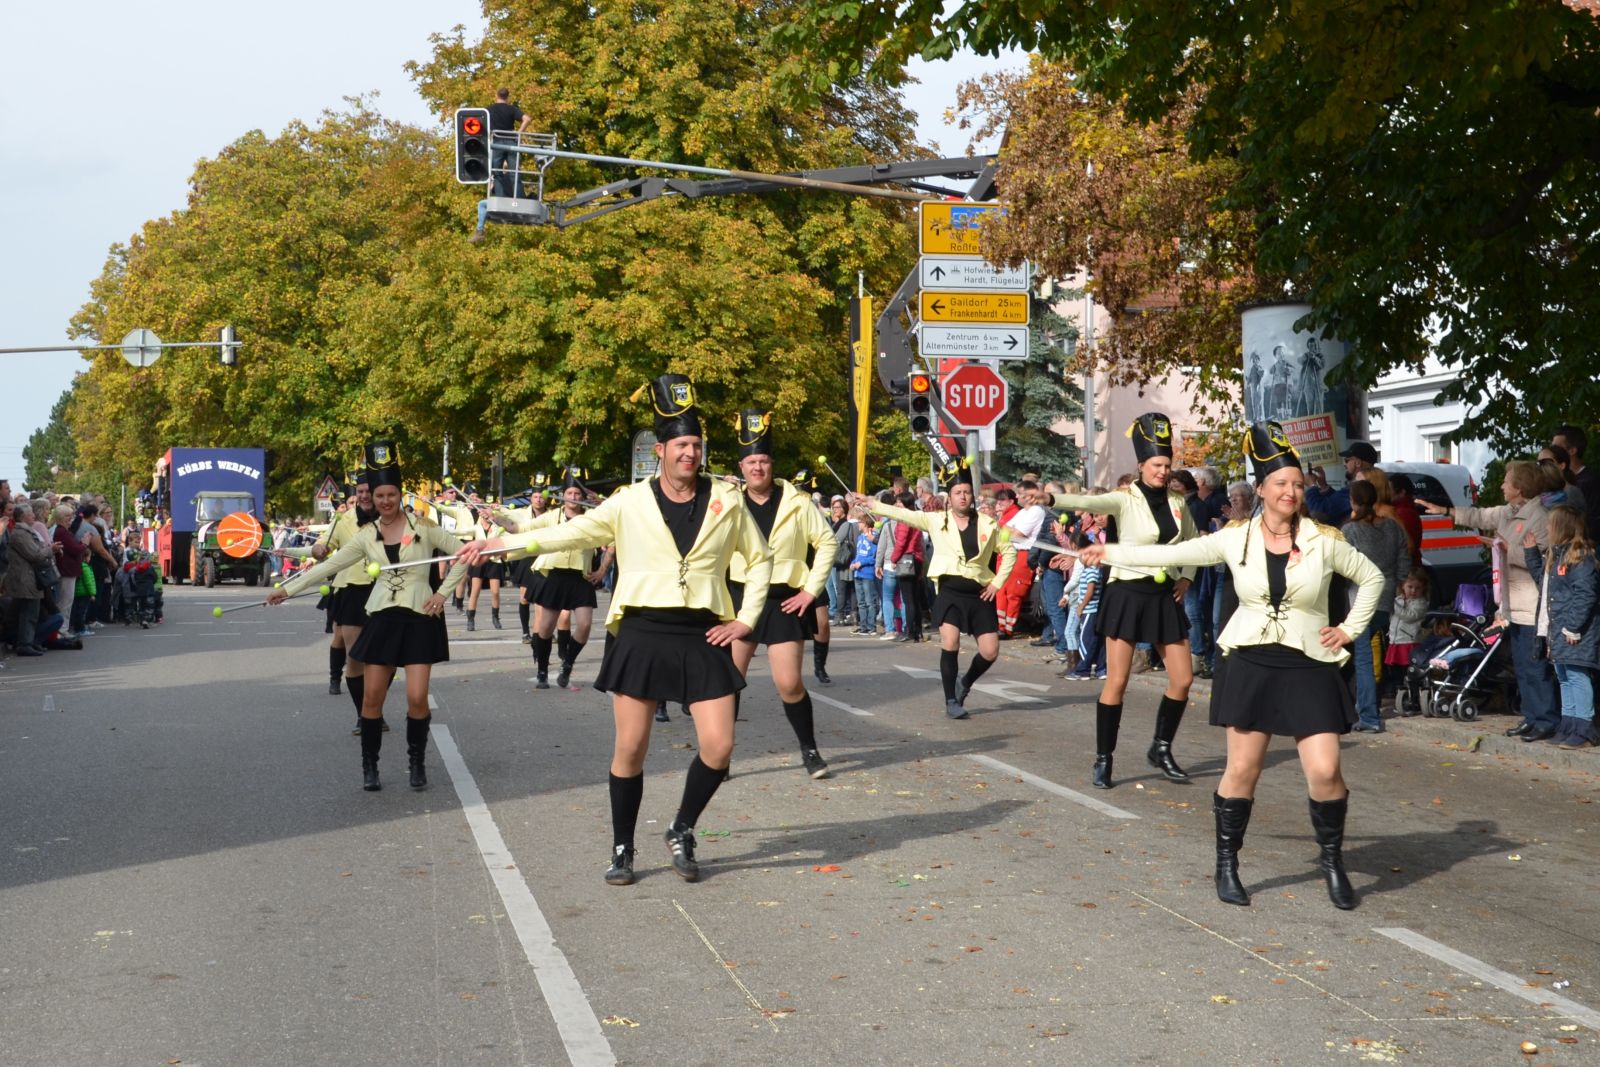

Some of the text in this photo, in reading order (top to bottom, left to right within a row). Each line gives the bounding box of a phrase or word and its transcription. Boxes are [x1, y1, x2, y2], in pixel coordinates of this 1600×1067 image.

[950, 243, 981, 252] Roßfe
[964, 266, 1005, 275] Hofwiesn
[990, 277, 1024, 286] Flügelau
[950, 297, 988, 307] Gaildorf
[997, 298, 1009, 308] 25
[950, 309, 998, 319] Frankenhardt
[1002, 310, 1008, 319] 4
[946, 332, 980, 341] Zentrum
[926, 342, 978, 351] Altenmünster
[950, 384, 1000, 408] STOP
[217, 460, 261, 480] WERFEN
